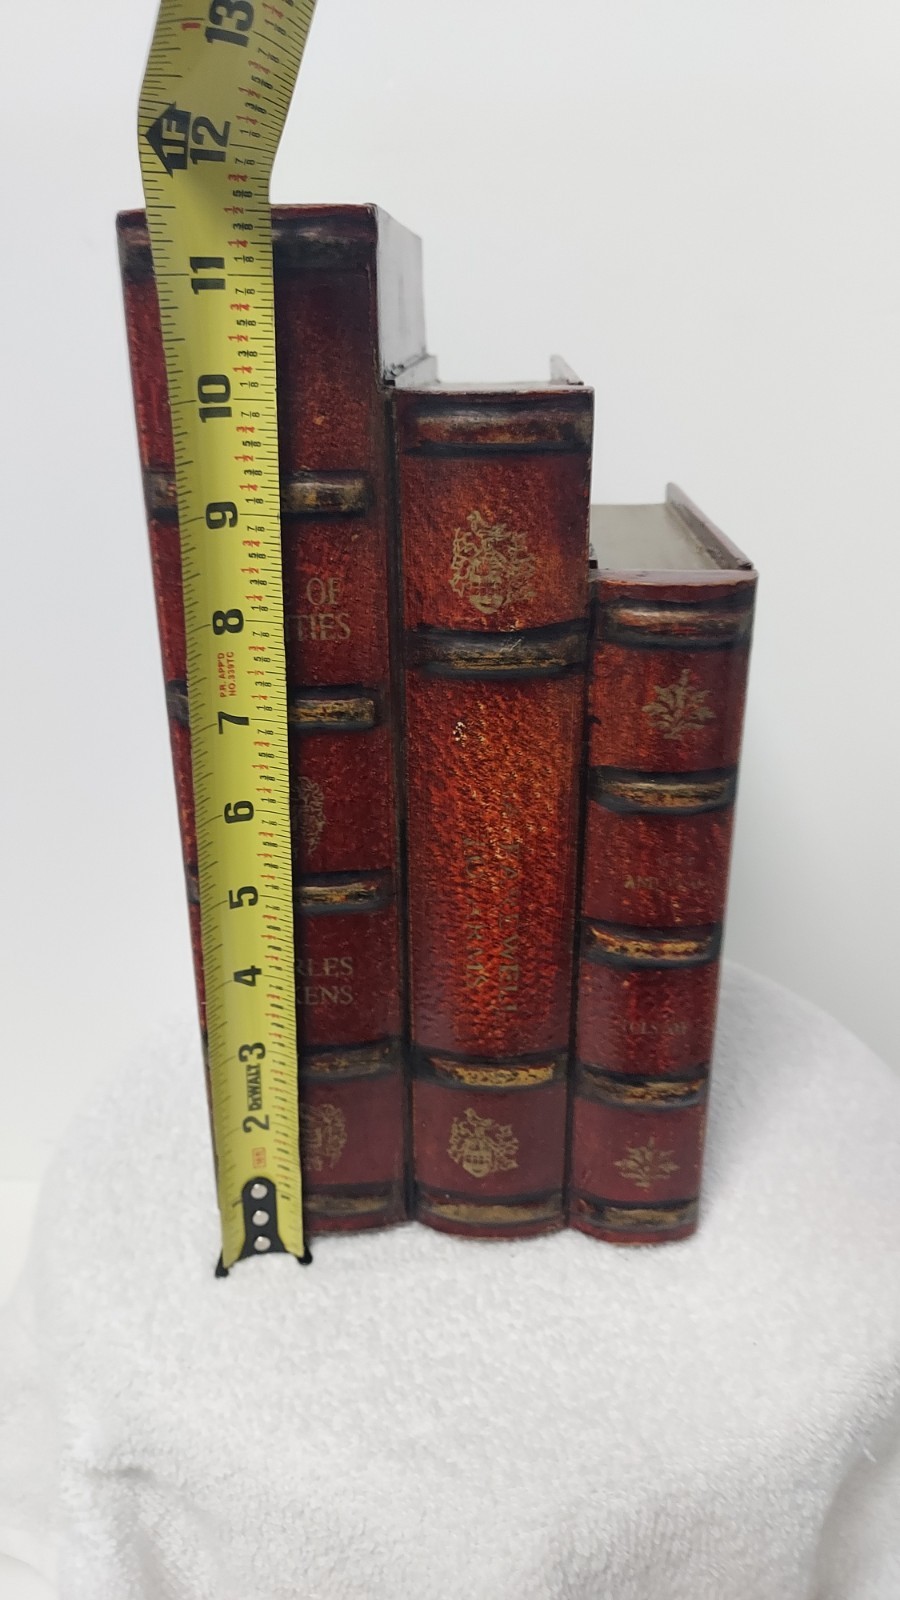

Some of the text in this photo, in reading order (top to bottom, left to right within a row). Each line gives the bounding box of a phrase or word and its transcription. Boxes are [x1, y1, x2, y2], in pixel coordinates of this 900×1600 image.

[205, 0, 254, 48] 13
[190, 116, 230, 165] 12
[190, 257, 225, 295] 11
[198, 374, 232, 423] 10
[206, 501, 238, 530] 9
[306, 577, 339, 605] OF
[213, 609, 244, 635] 8
[218, 711, 249, 734] 7
[224, 801, 254, 823] 6
[229, 886, 259, 909] 5
[234, 965, 261, 986] 4
[239, 1042, 266, 1063] 3
[243, 1114, 270, 1133] 2
